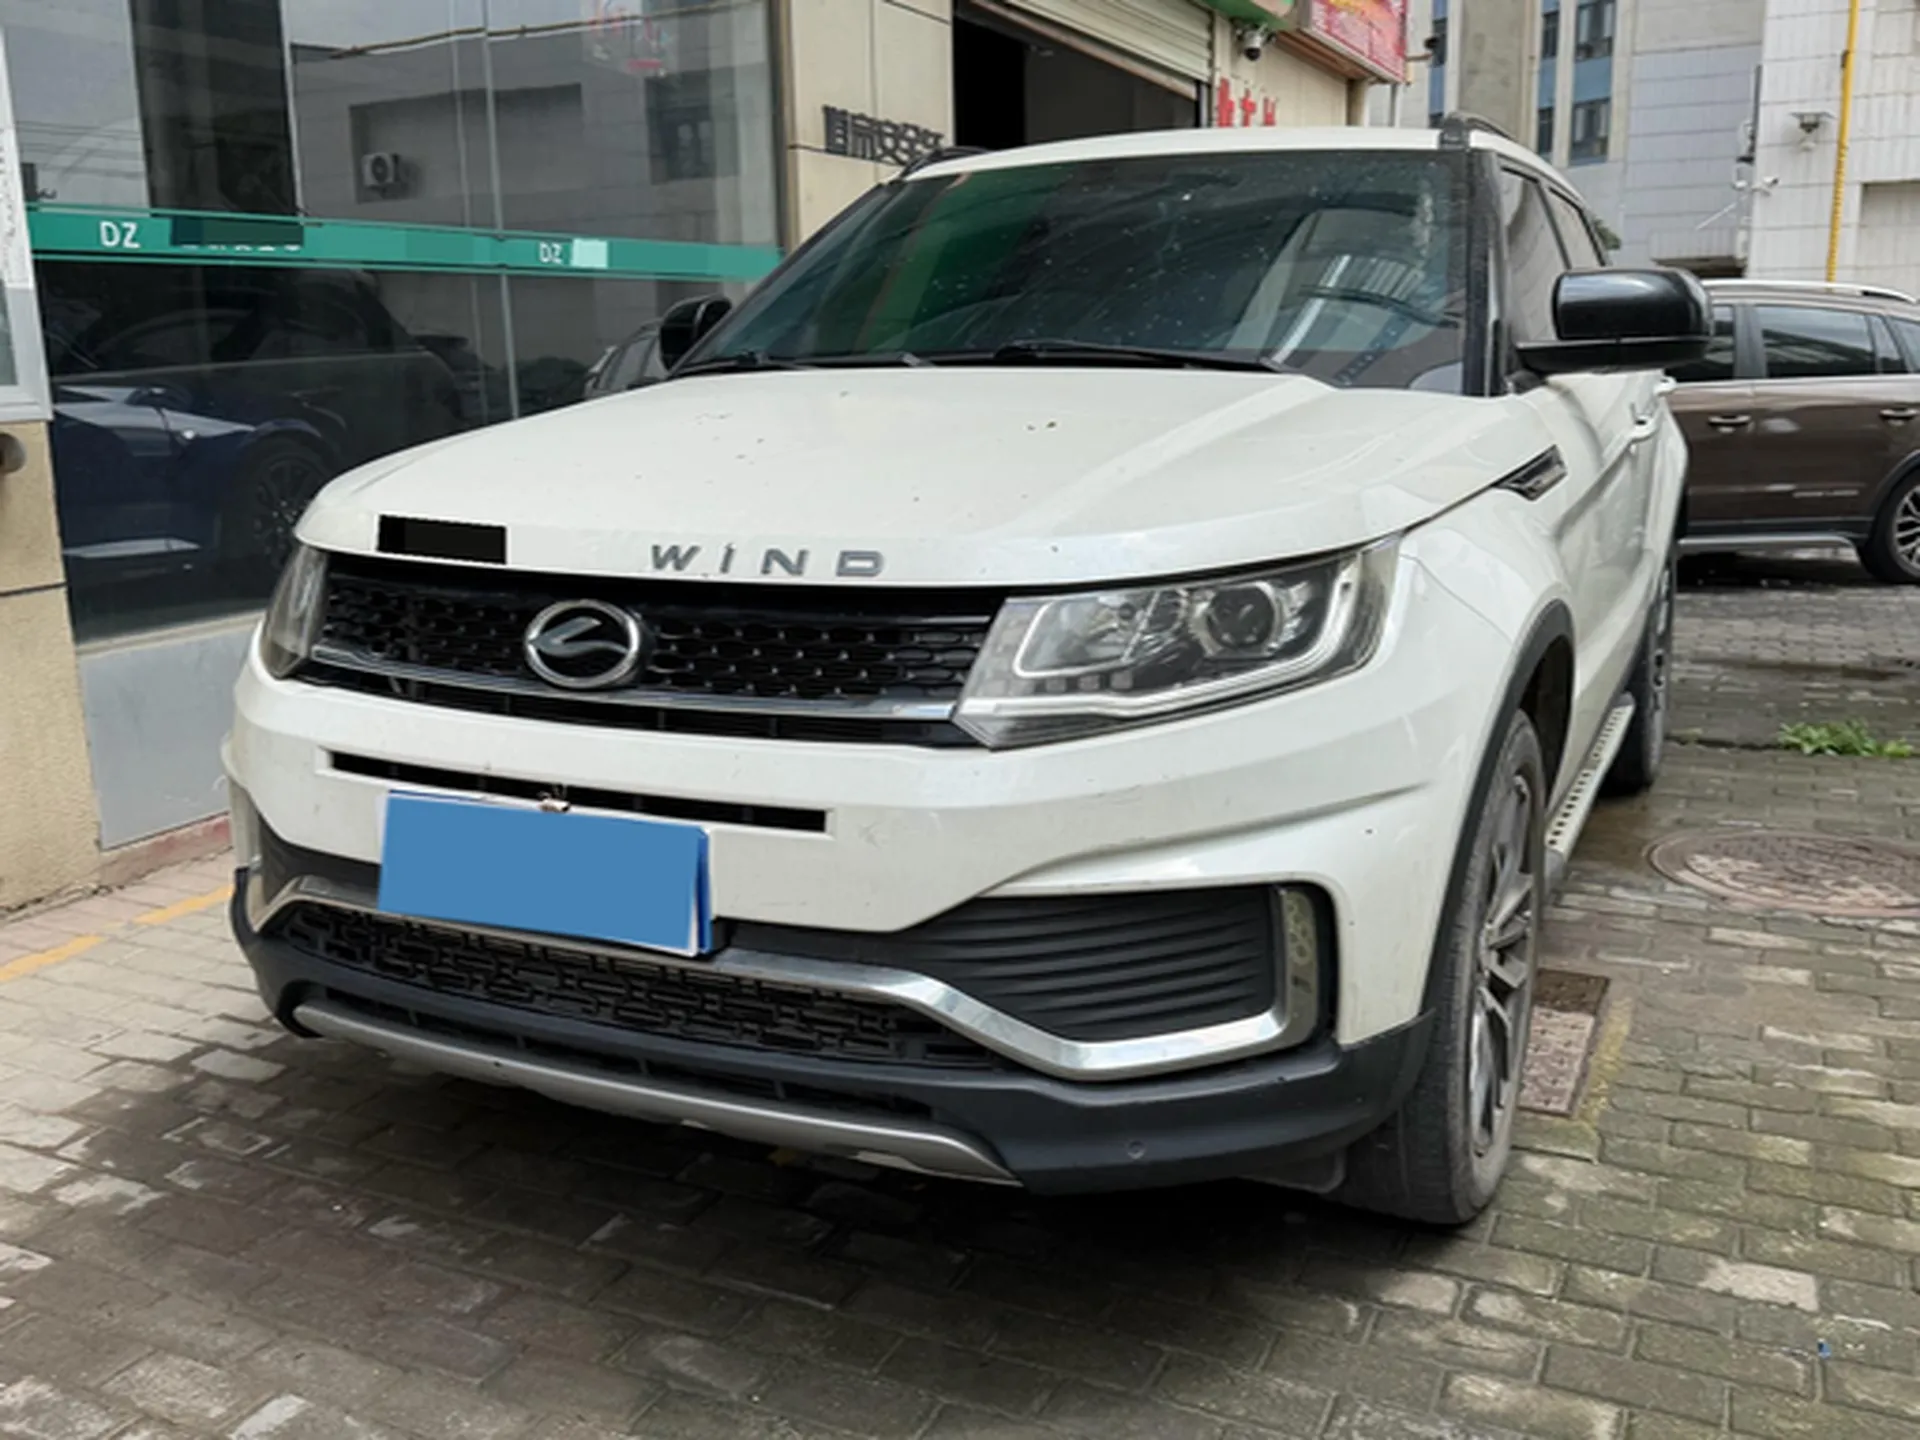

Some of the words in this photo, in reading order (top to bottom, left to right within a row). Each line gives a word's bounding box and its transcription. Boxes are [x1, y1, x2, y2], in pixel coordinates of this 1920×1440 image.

[99, 220, 141, 249] DZ
[539, 241, 563, 265] DZ
[650, 542, 885, 578] WIND
